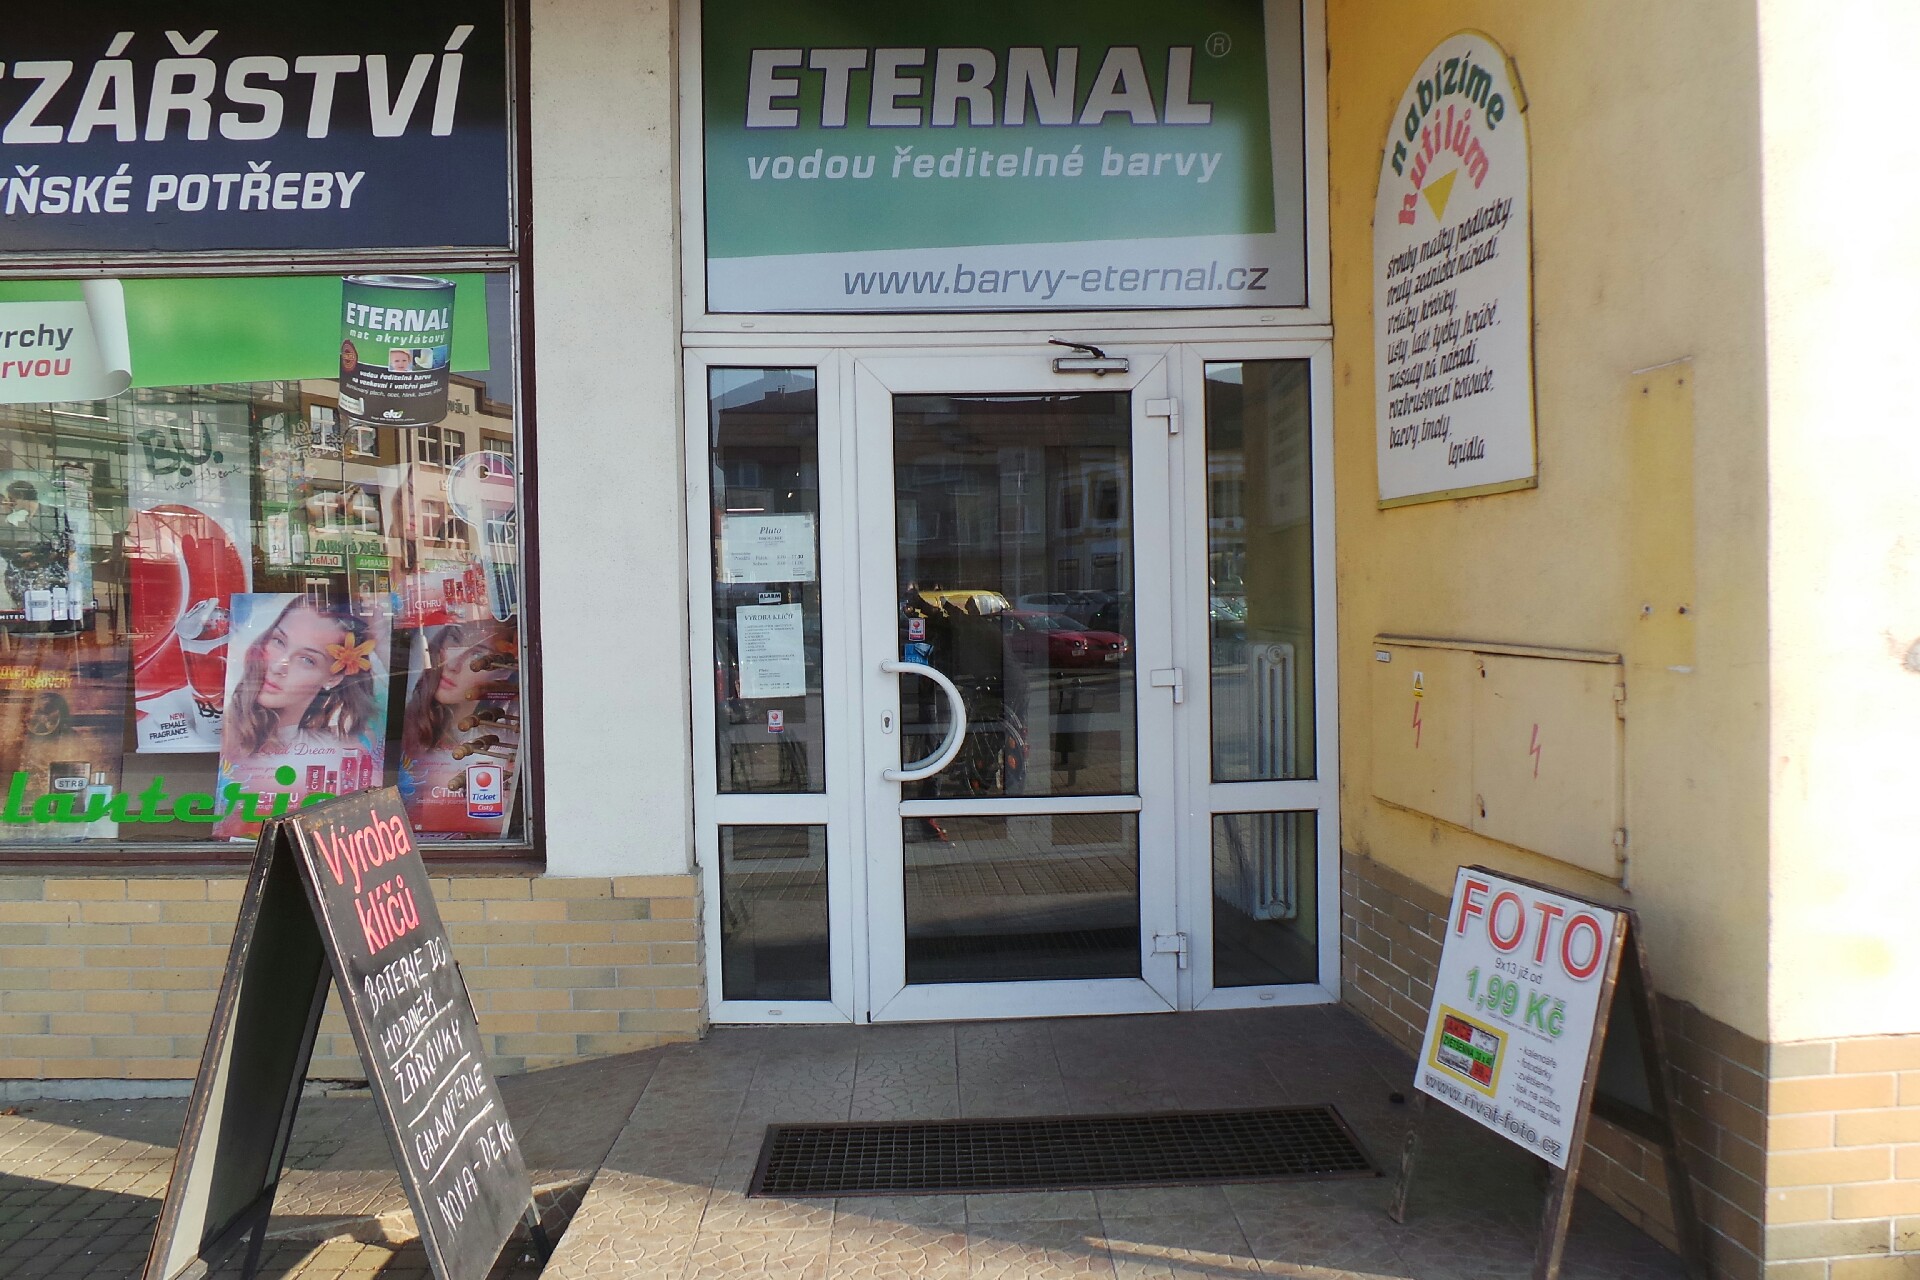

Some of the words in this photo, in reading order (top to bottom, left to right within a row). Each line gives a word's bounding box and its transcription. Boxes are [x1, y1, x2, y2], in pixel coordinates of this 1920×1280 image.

[0, 25, 474, 144] ZÁŘSTVÍ
[744, 46, 1213, 130] ETERNAL
[1391, 50, 1504, 177] nabízíme
[747, 148, 875, 181] vodou
[891, 144, 1084, 180] ředitelné
[1101, 146, 1223, 184] barvy
[146, 161, 366, 213] POTŘEBY
[843, 260, 1270, 301] www.barvy-eternal.cz
[346, 302, 449, 332] ETERNAL
[349, 329, 369, 340] mat
[375, 331, 446, 346] akrylátový
[149, 728, 188, 740] FRAGRANCE
[160, 720, 187, 730] FEMALE
[169, 712, 185, 720] NEW
[294, 742, 337, 756] Dream
[58, 780, 84, 788] STR8
[472, 793, 497, 801] Ticket
[313, 809, 412, 894] Výroba
[354, 874, 420, 955] klíčů
[1455, 877, 1604, 981] FOTO
[364, 947, 429, 1018] BATERIE
[425, 936, 446, 972] DO
[1494, 957, 1517, 976] 9x13
[1529, 972, 1543, 985] od
[1466, 966, 1519, 1017] 1,99
[1523, 989, 1568, 1038] Kč
[415, 1062, 487, 1171] GALANTERIE
